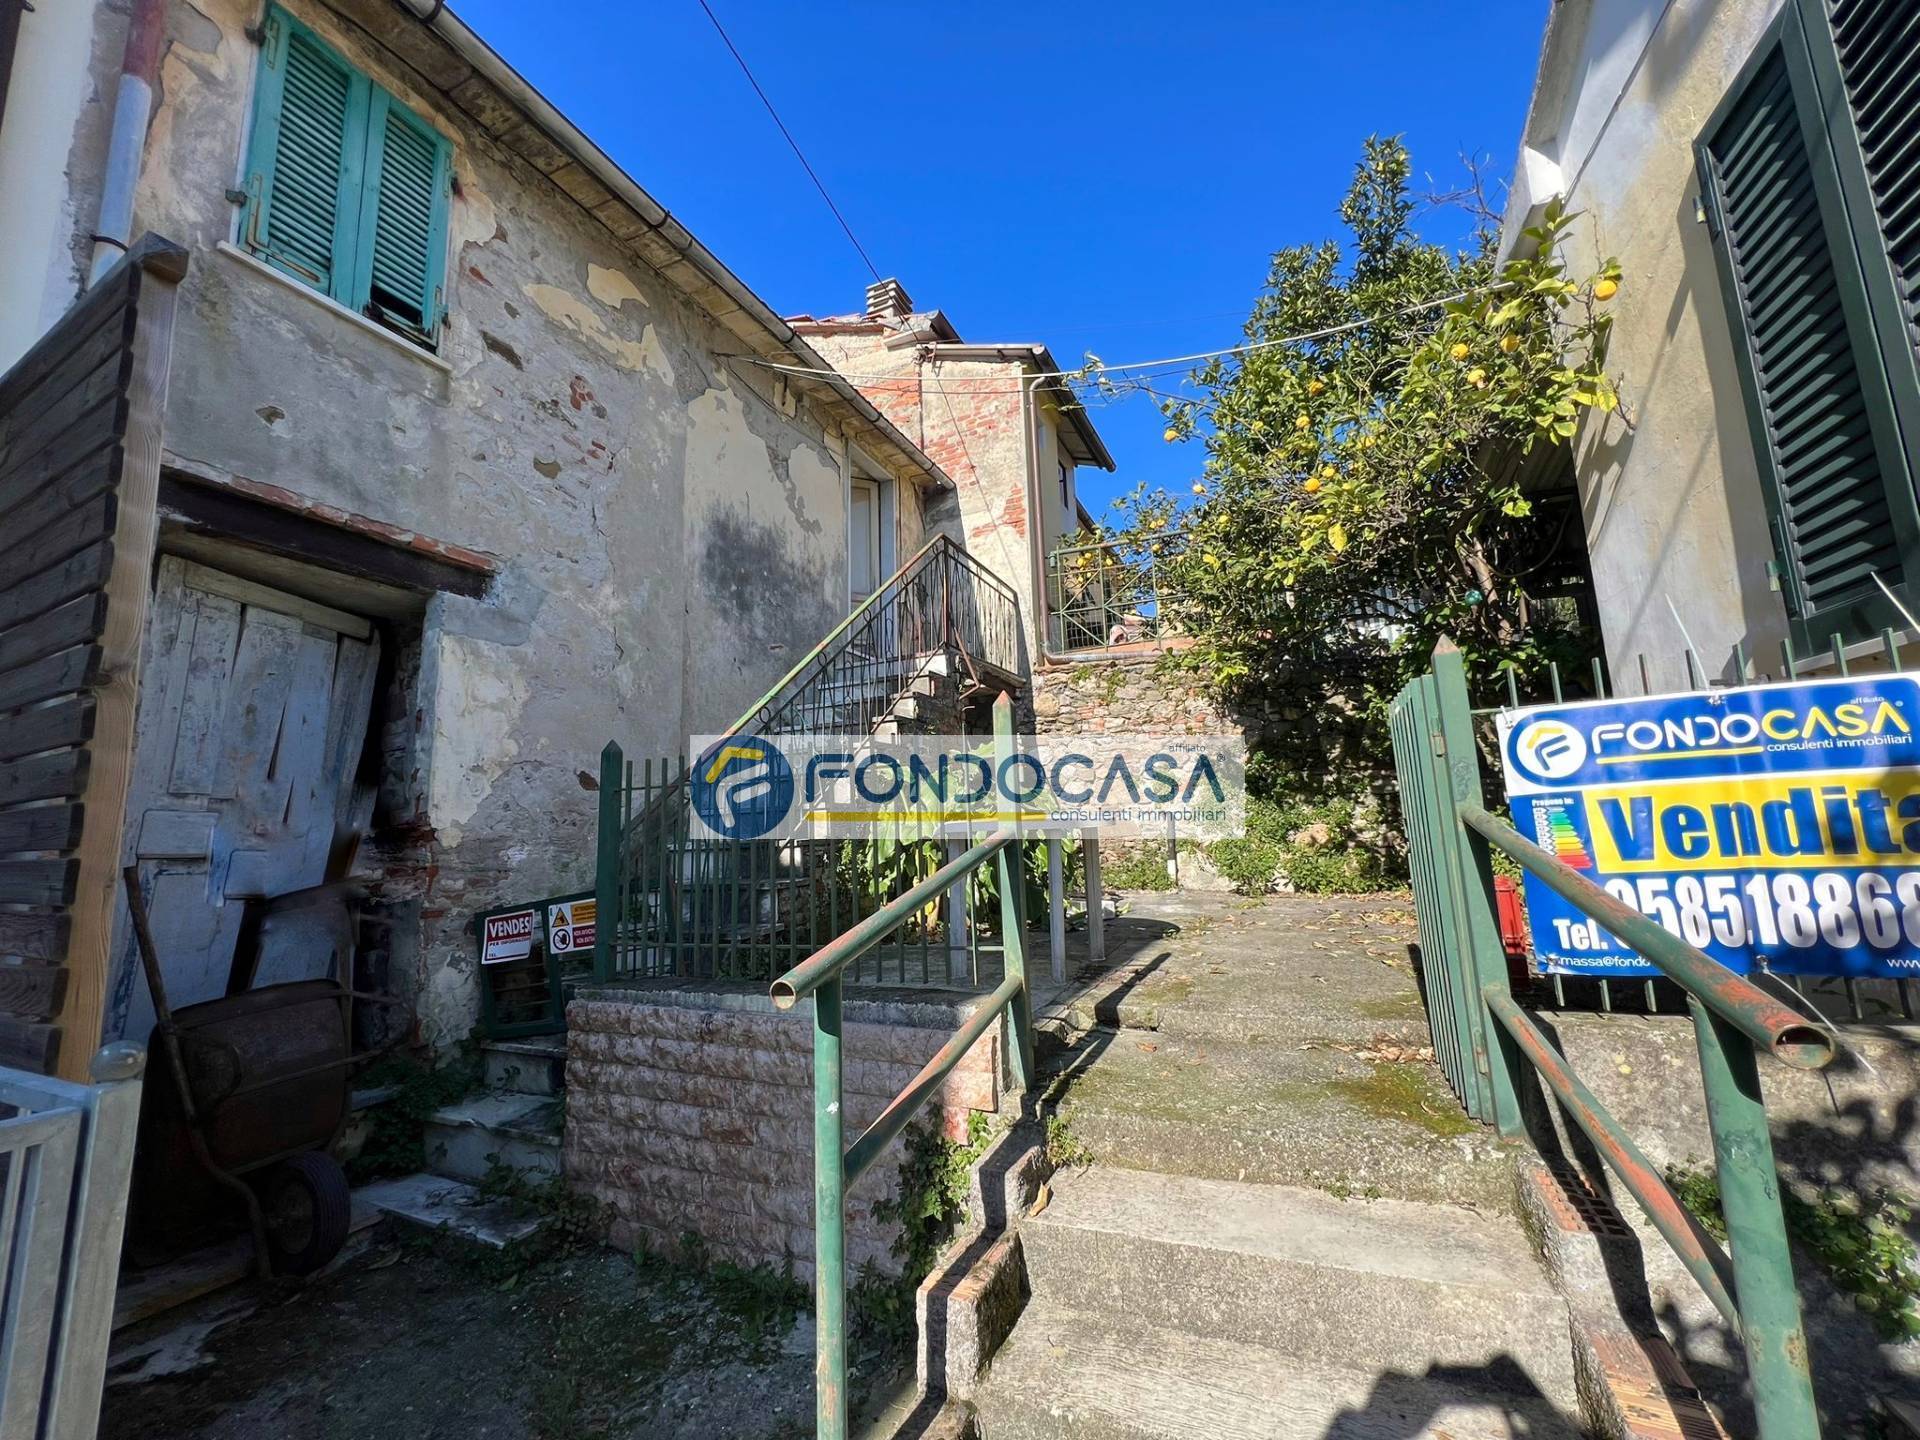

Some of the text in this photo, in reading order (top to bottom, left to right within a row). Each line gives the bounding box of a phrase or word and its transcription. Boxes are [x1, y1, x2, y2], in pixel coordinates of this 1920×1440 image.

[1592, 701, 1911, 754] FONDOCASA
[1767, 733, 1913, 752] consulenti immobiliari
[1552, 918, 1609, 950] Tel.
[1560, 955, 1651, 968] massa@fondo
